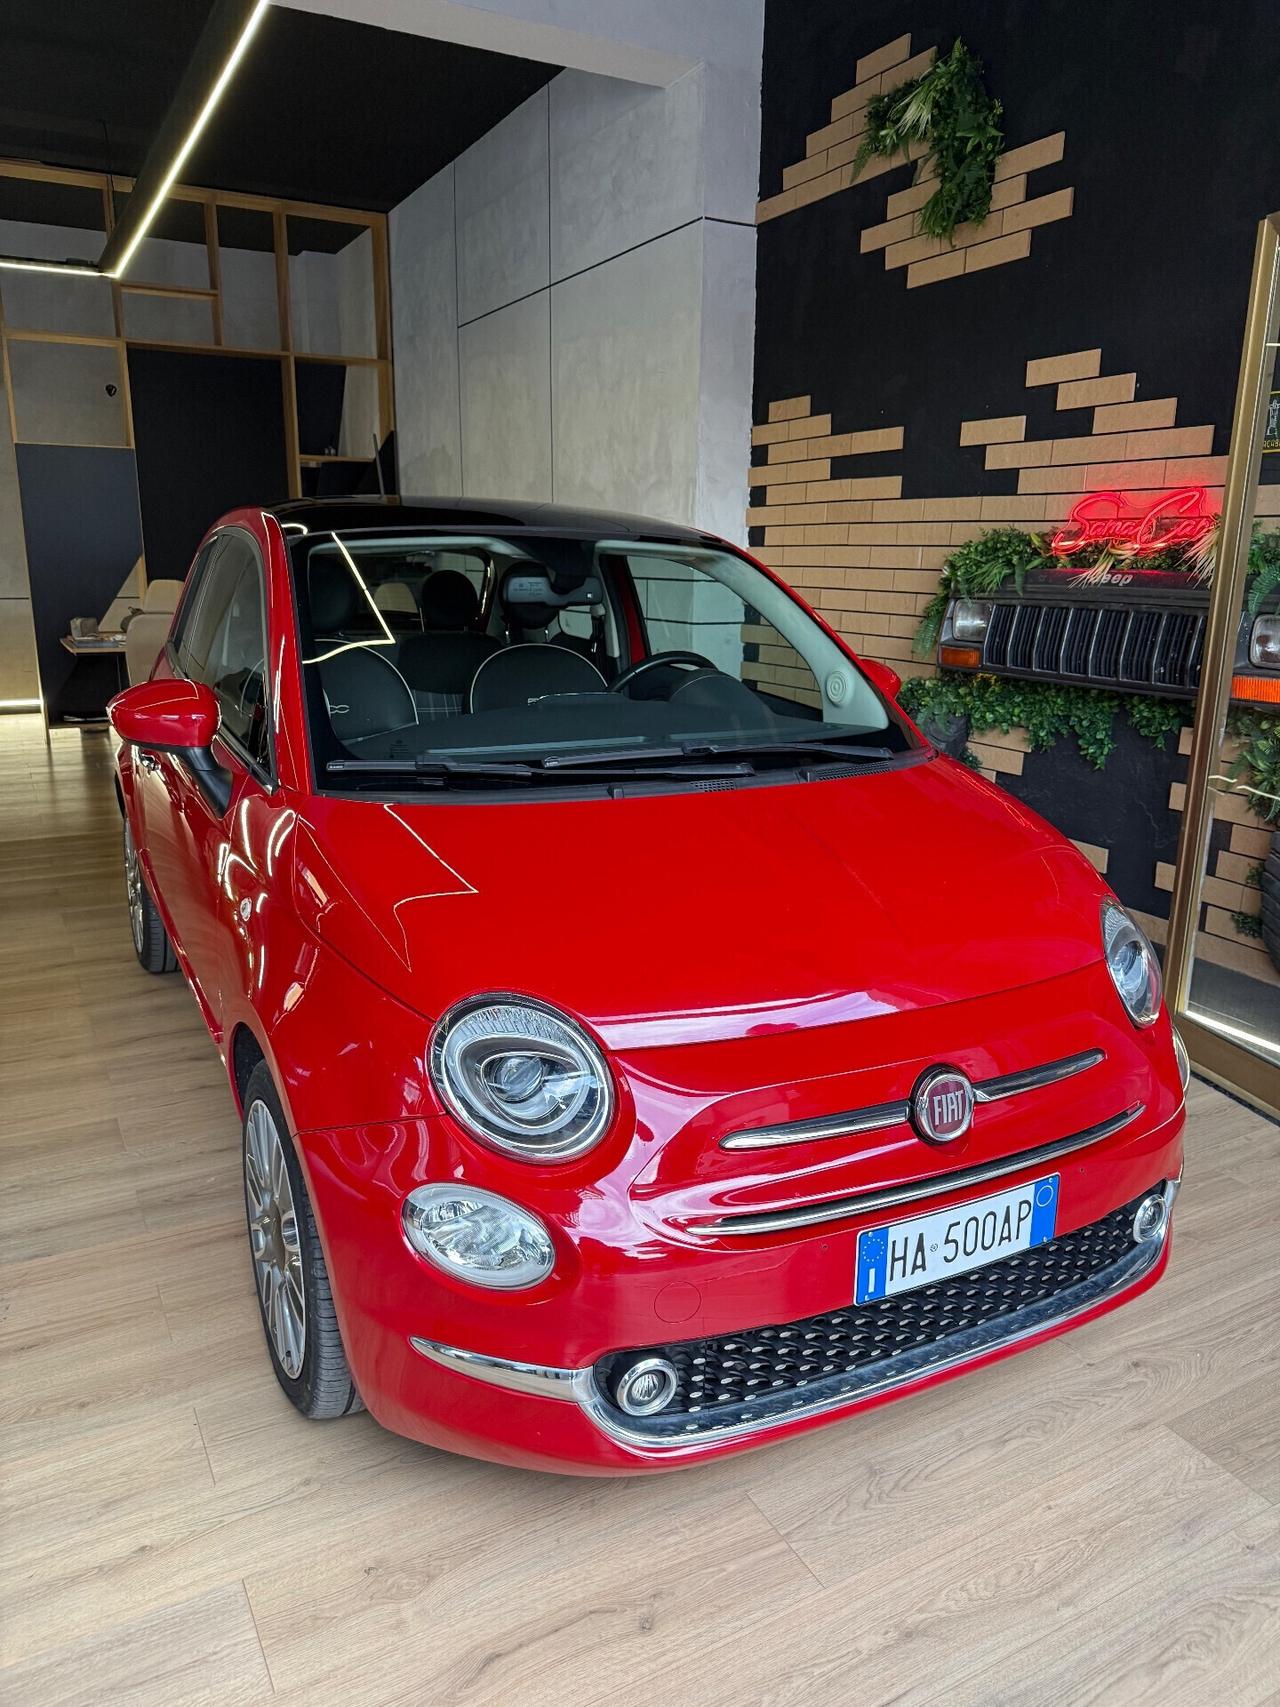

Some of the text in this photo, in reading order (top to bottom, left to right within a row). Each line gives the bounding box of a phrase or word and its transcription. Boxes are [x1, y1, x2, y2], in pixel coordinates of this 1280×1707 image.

[1095, 573, 1133, 587] eep
[932, 1089, 964, 1126] FIAT
[889, 1199, 1033, 1282] HA 500AP
